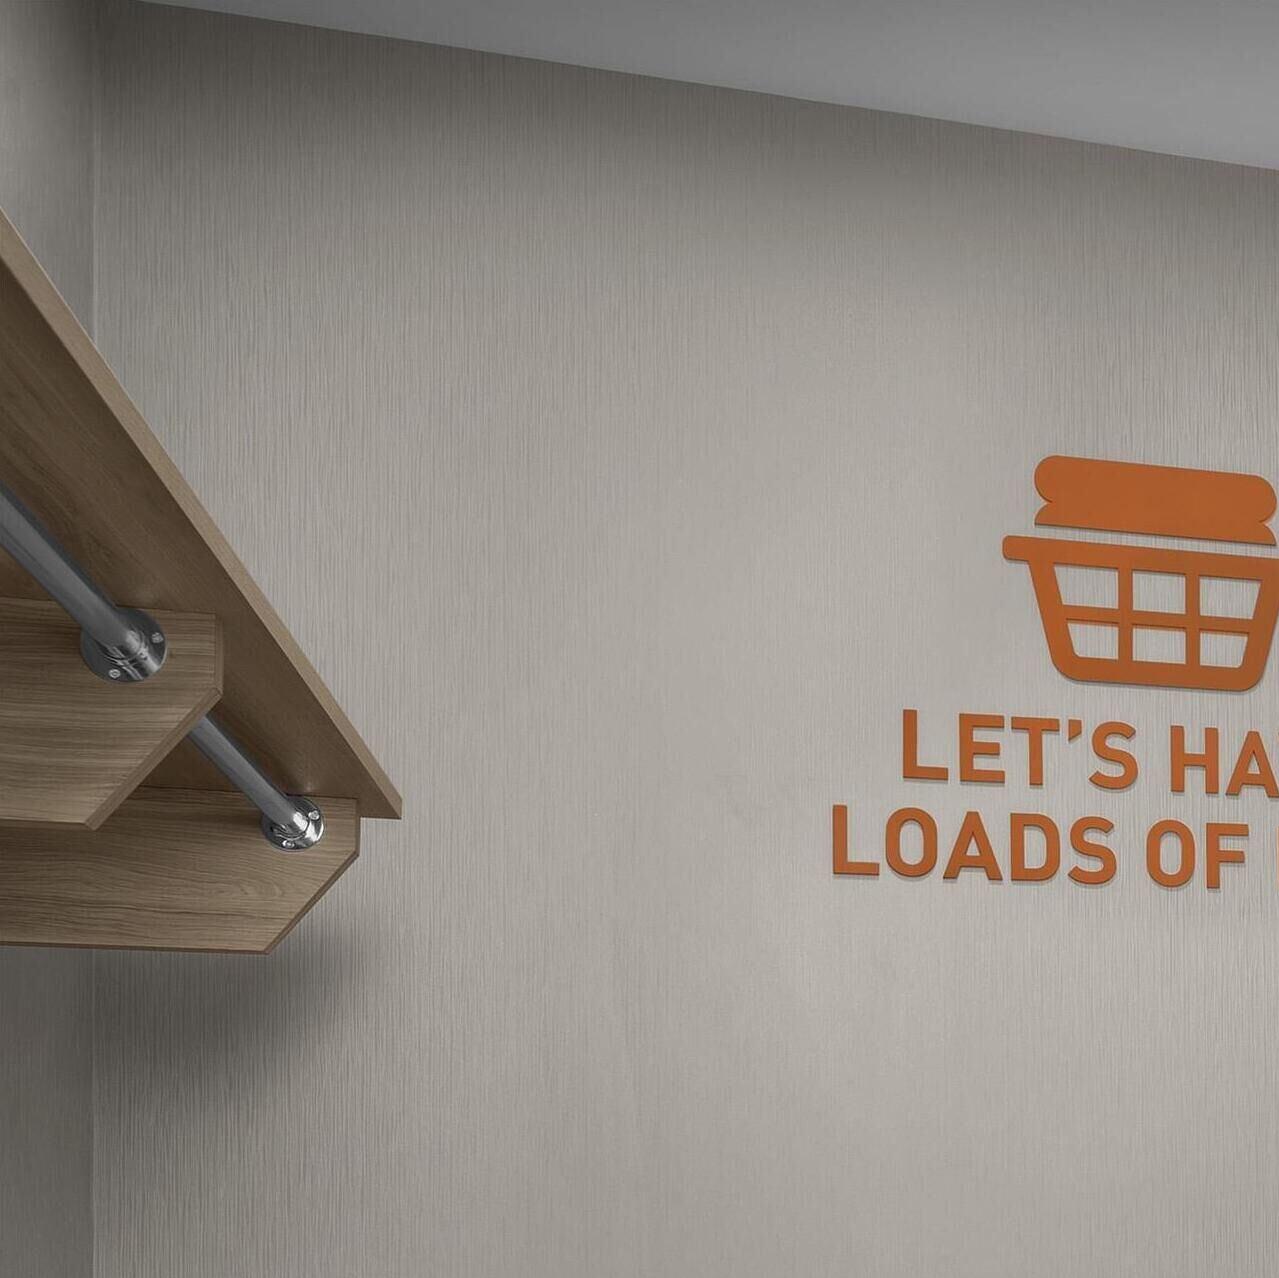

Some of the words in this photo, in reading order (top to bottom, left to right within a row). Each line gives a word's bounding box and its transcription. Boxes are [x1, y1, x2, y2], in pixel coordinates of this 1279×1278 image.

[902, 709, 1139, 790] LET'S
[832, 803, 1117, 885] LOADS
[1146, 818, 1249, 889] OF
